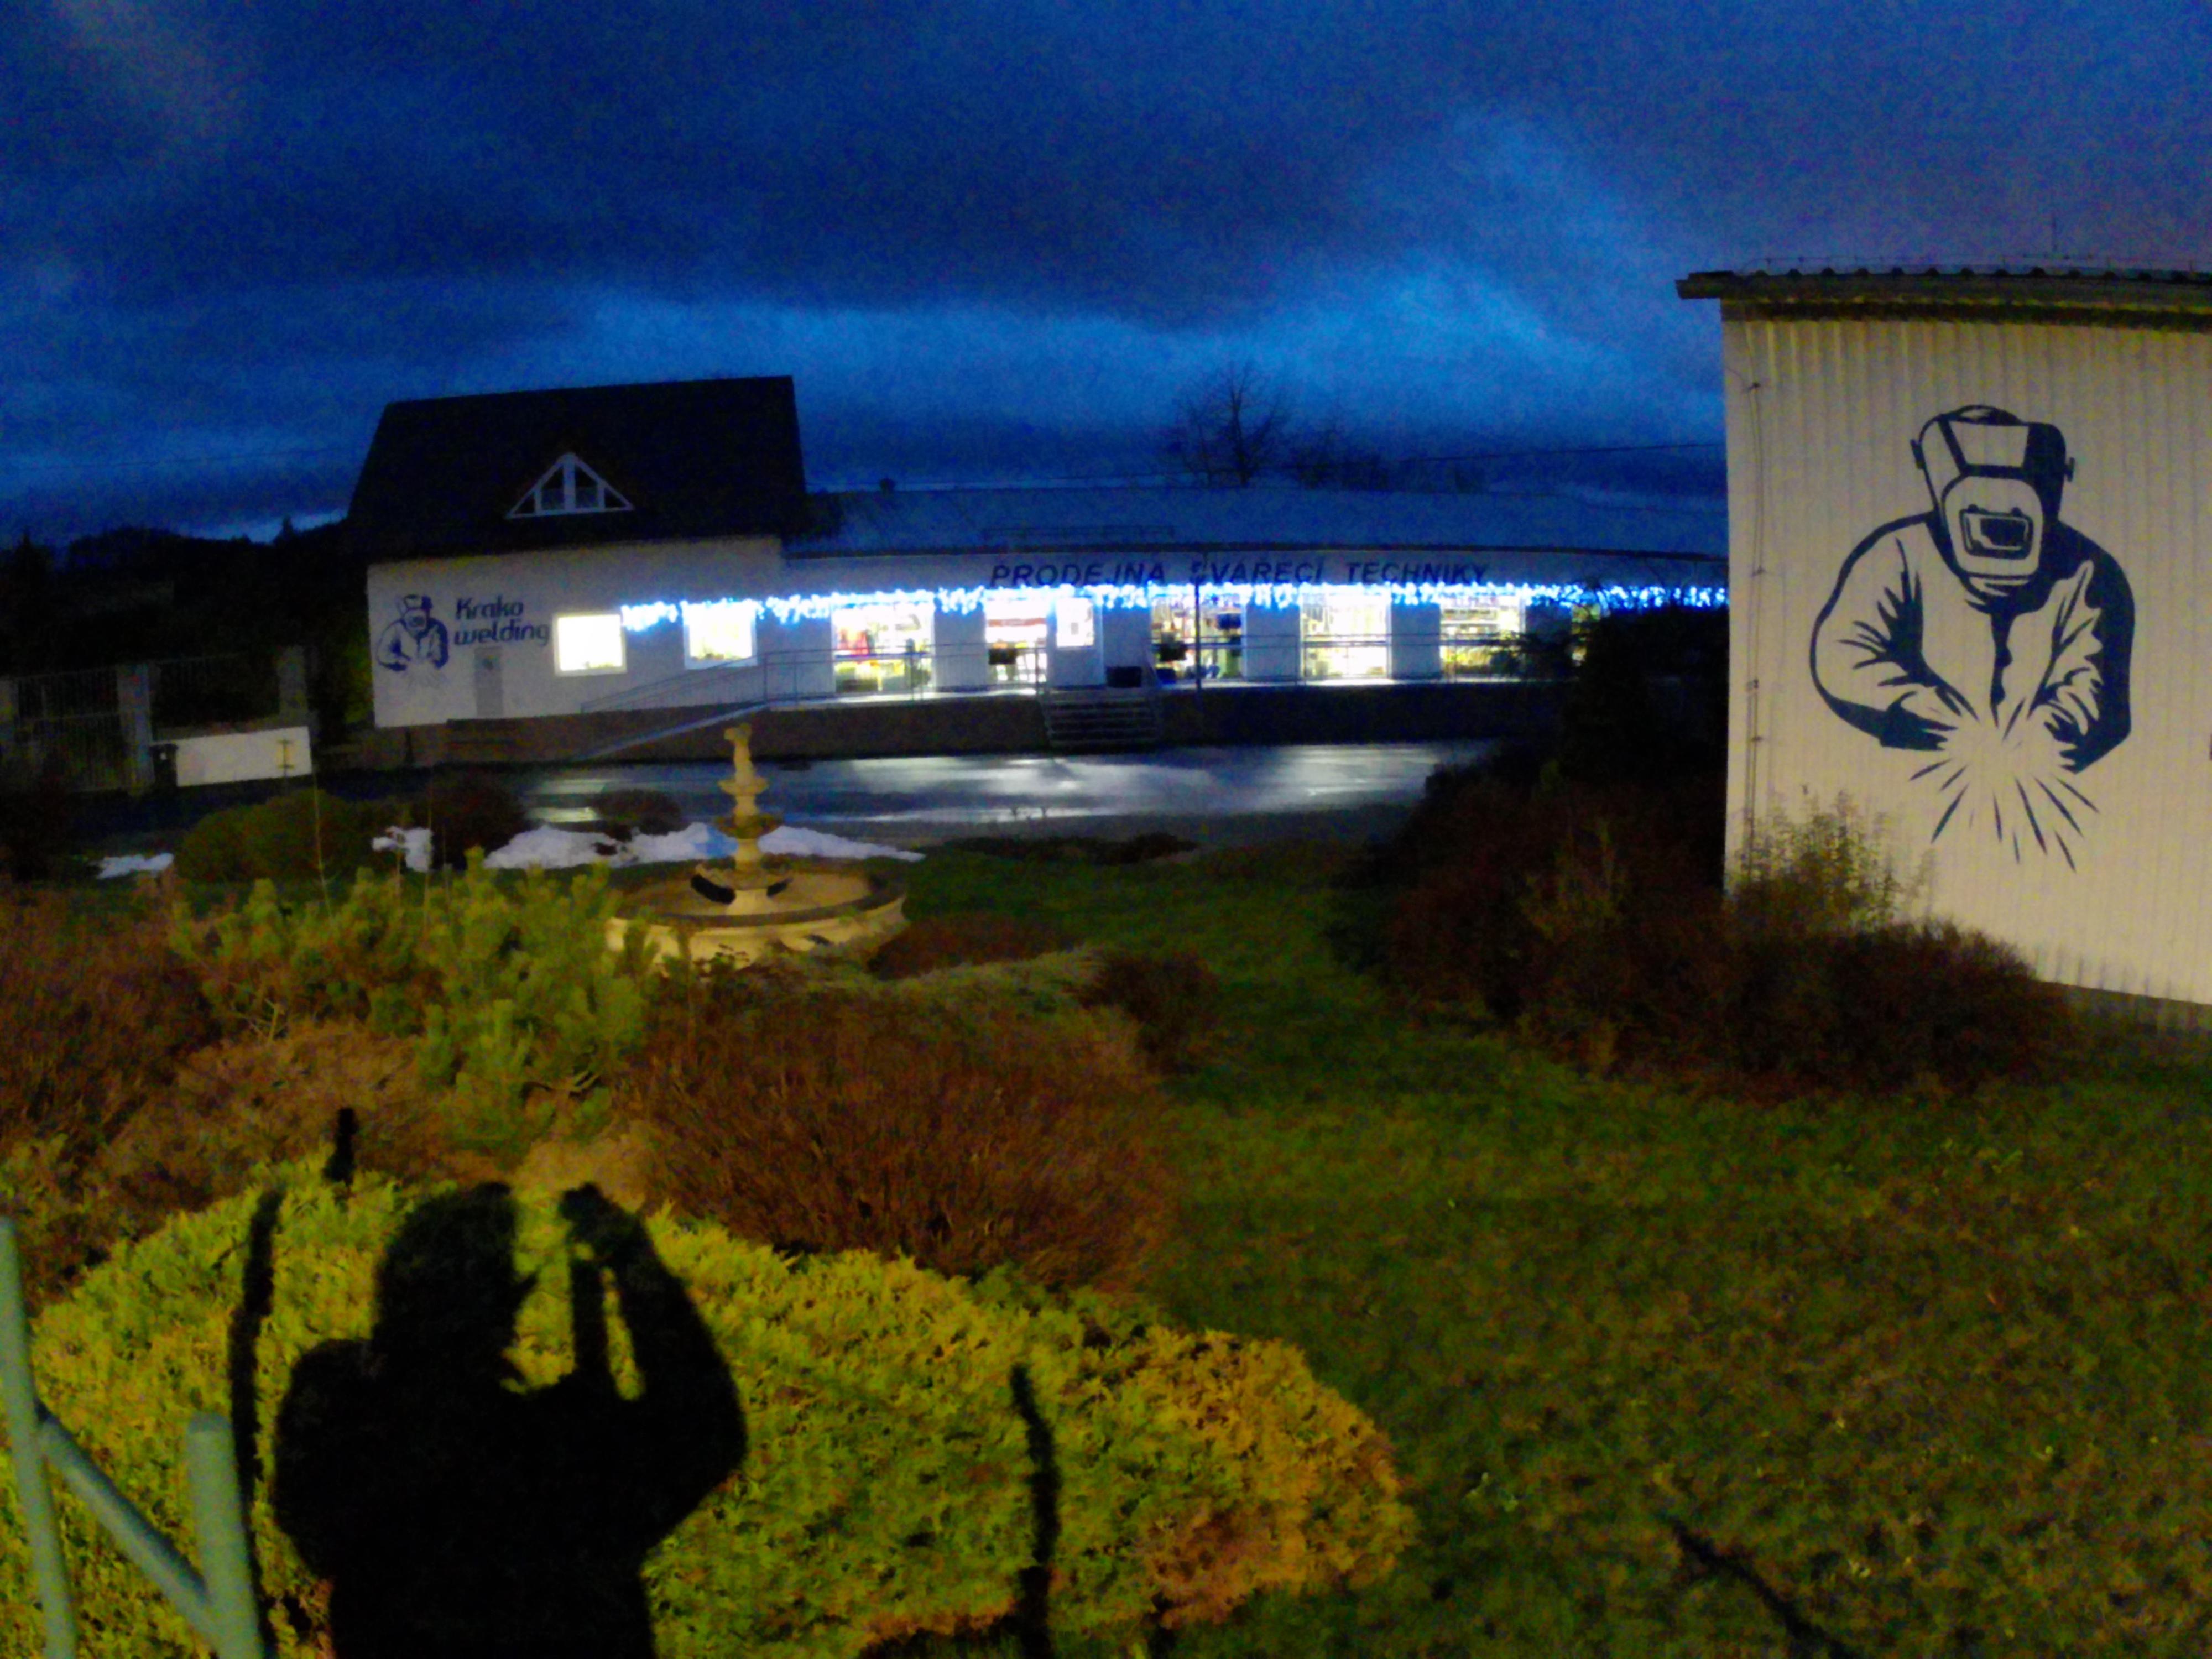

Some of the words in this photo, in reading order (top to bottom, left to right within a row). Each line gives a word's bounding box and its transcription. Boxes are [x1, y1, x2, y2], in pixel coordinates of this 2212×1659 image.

[1346, 562, 1489, 585] TECHNIKY
[456, 594, 524, 619] Krako
[455, 619, 550, 646] welding
